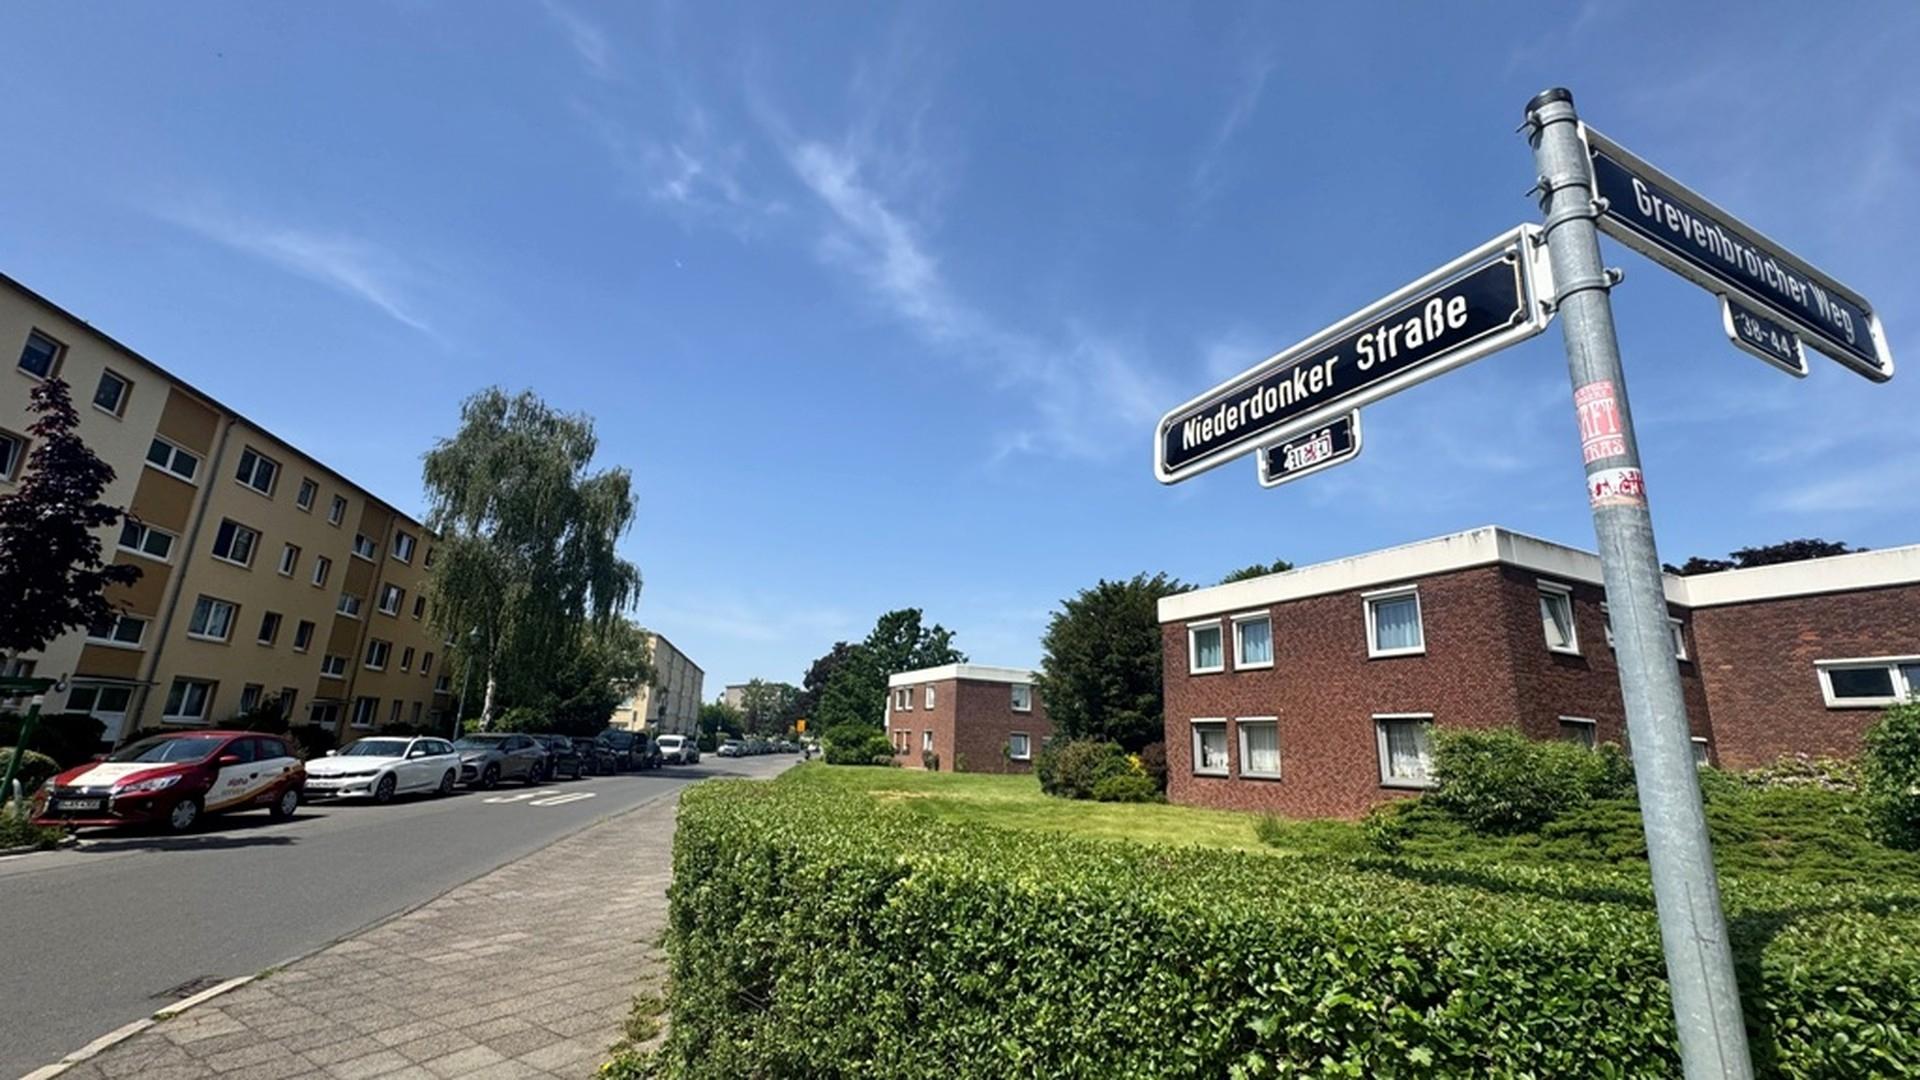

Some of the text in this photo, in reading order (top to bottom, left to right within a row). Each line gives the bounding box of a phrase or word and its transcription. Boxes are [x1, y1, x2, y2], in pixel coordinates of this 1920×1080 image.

[1631, 177, 1856, 344] Grevenbroicher Weg
[1741, 313, 1791, 357] 38-44
[1181, 354, 1340, 452] Niederdonker
[1356, 294, 1468, 371] Straße
